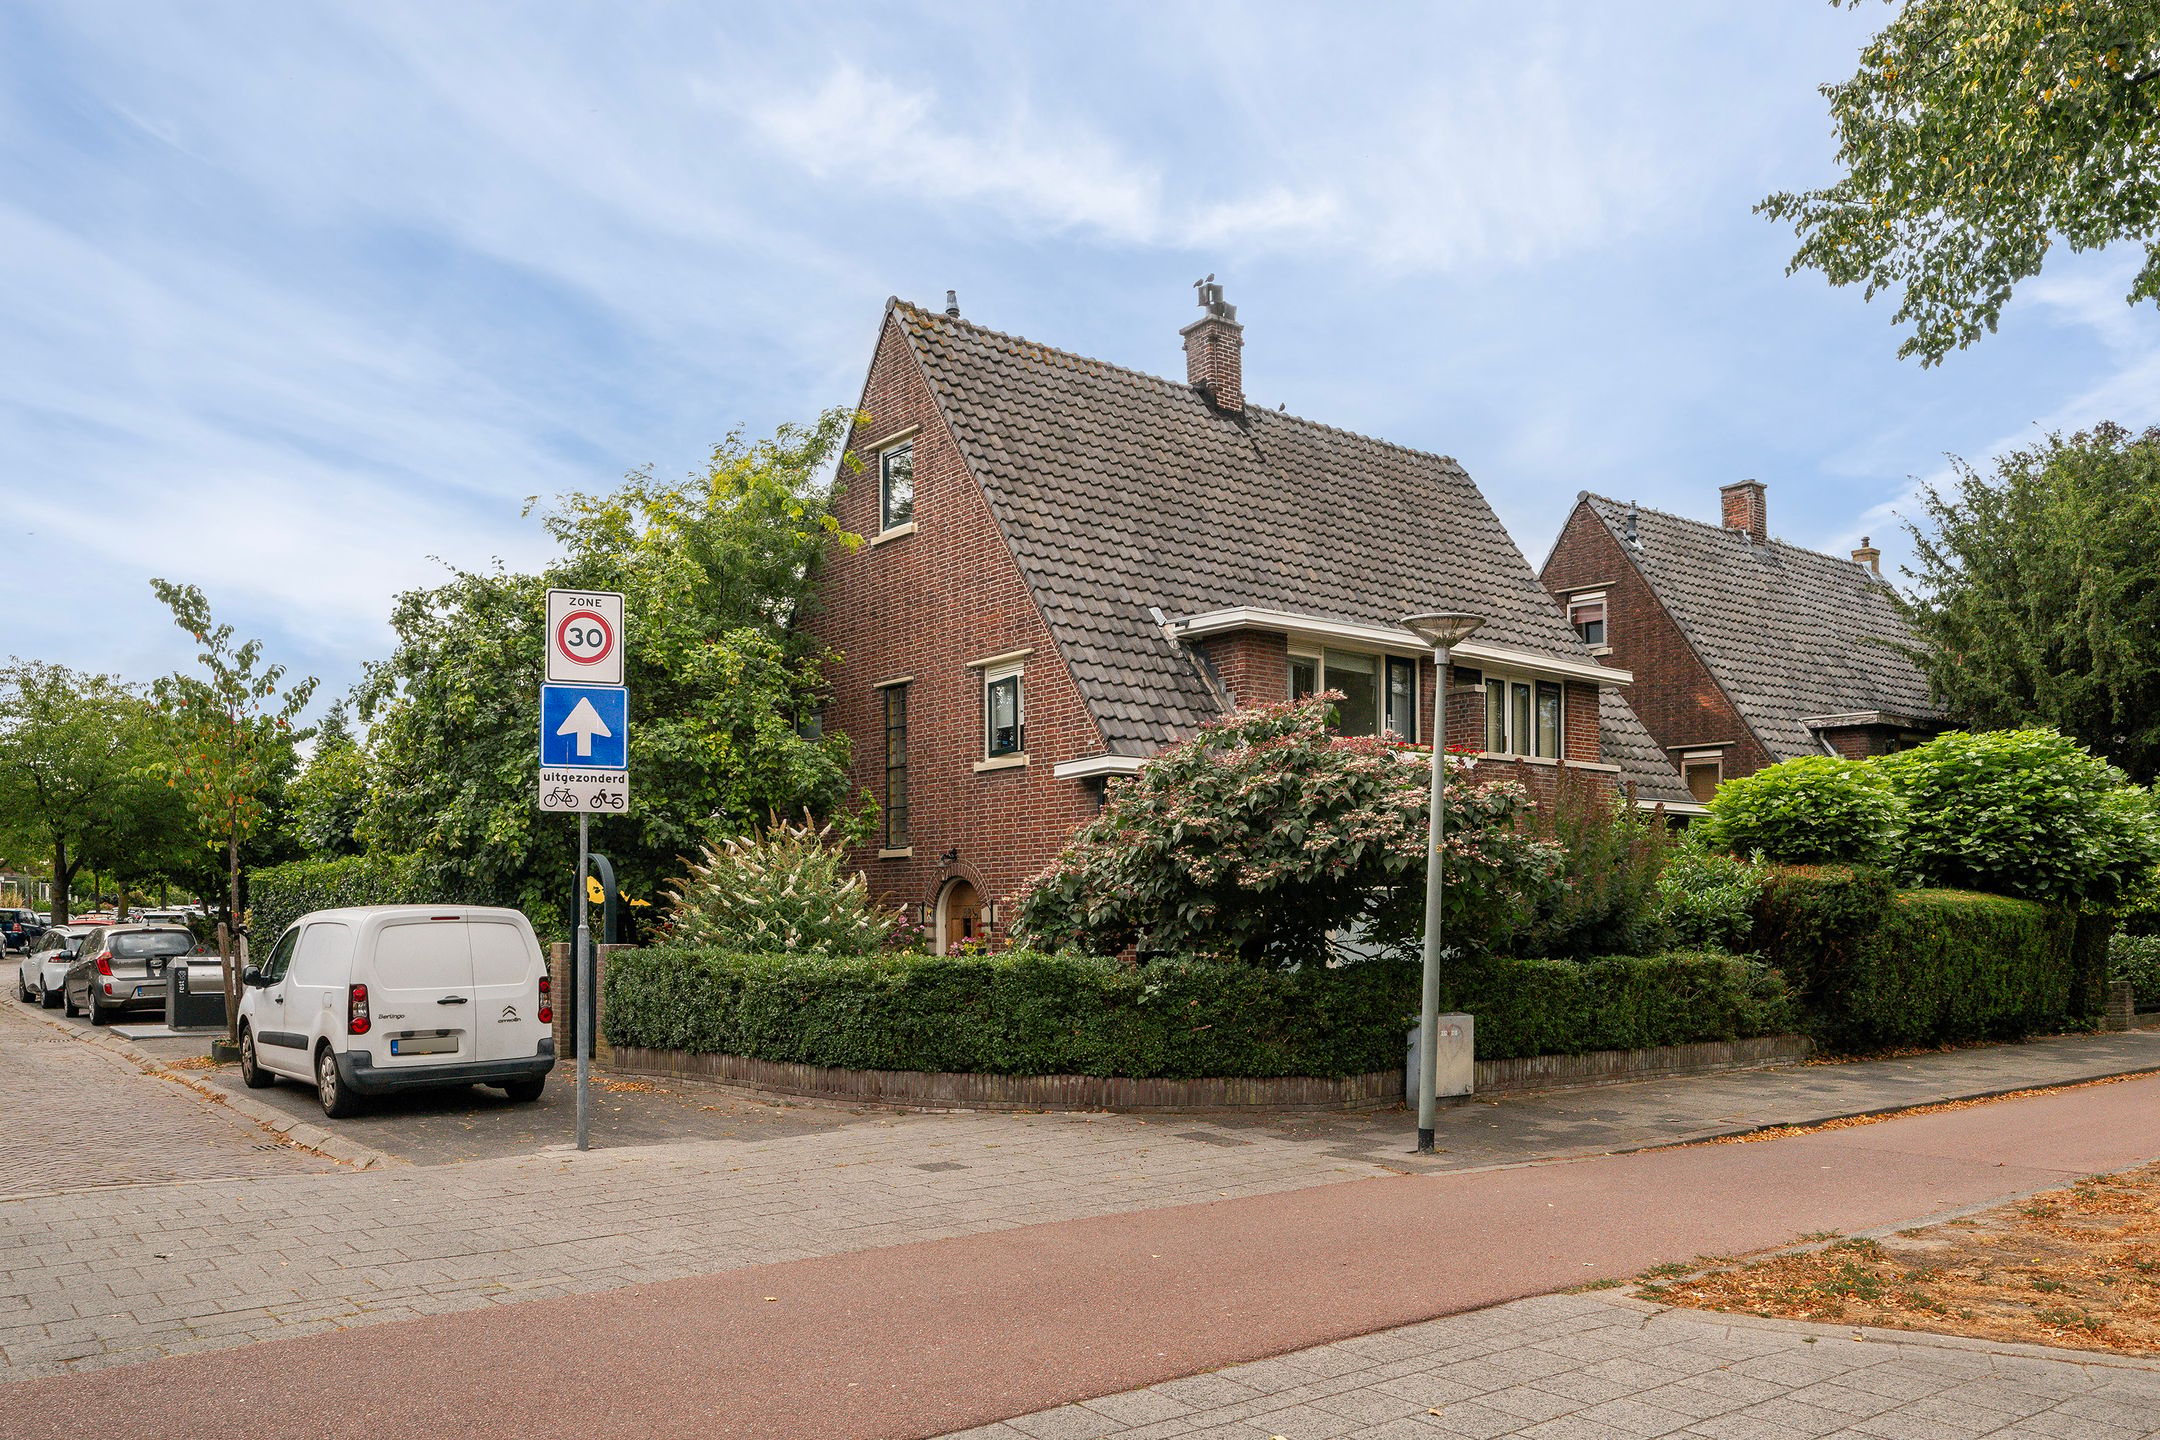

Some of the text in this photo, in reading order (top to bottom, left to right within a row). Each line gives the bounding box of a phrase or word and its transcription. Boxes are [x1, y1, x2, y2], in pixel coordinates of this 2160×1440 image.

[569, 597, 602, 608] ZONE
[567, 627, 603, 648] 30
[543, 773, 625, 785] uitgezonderd
